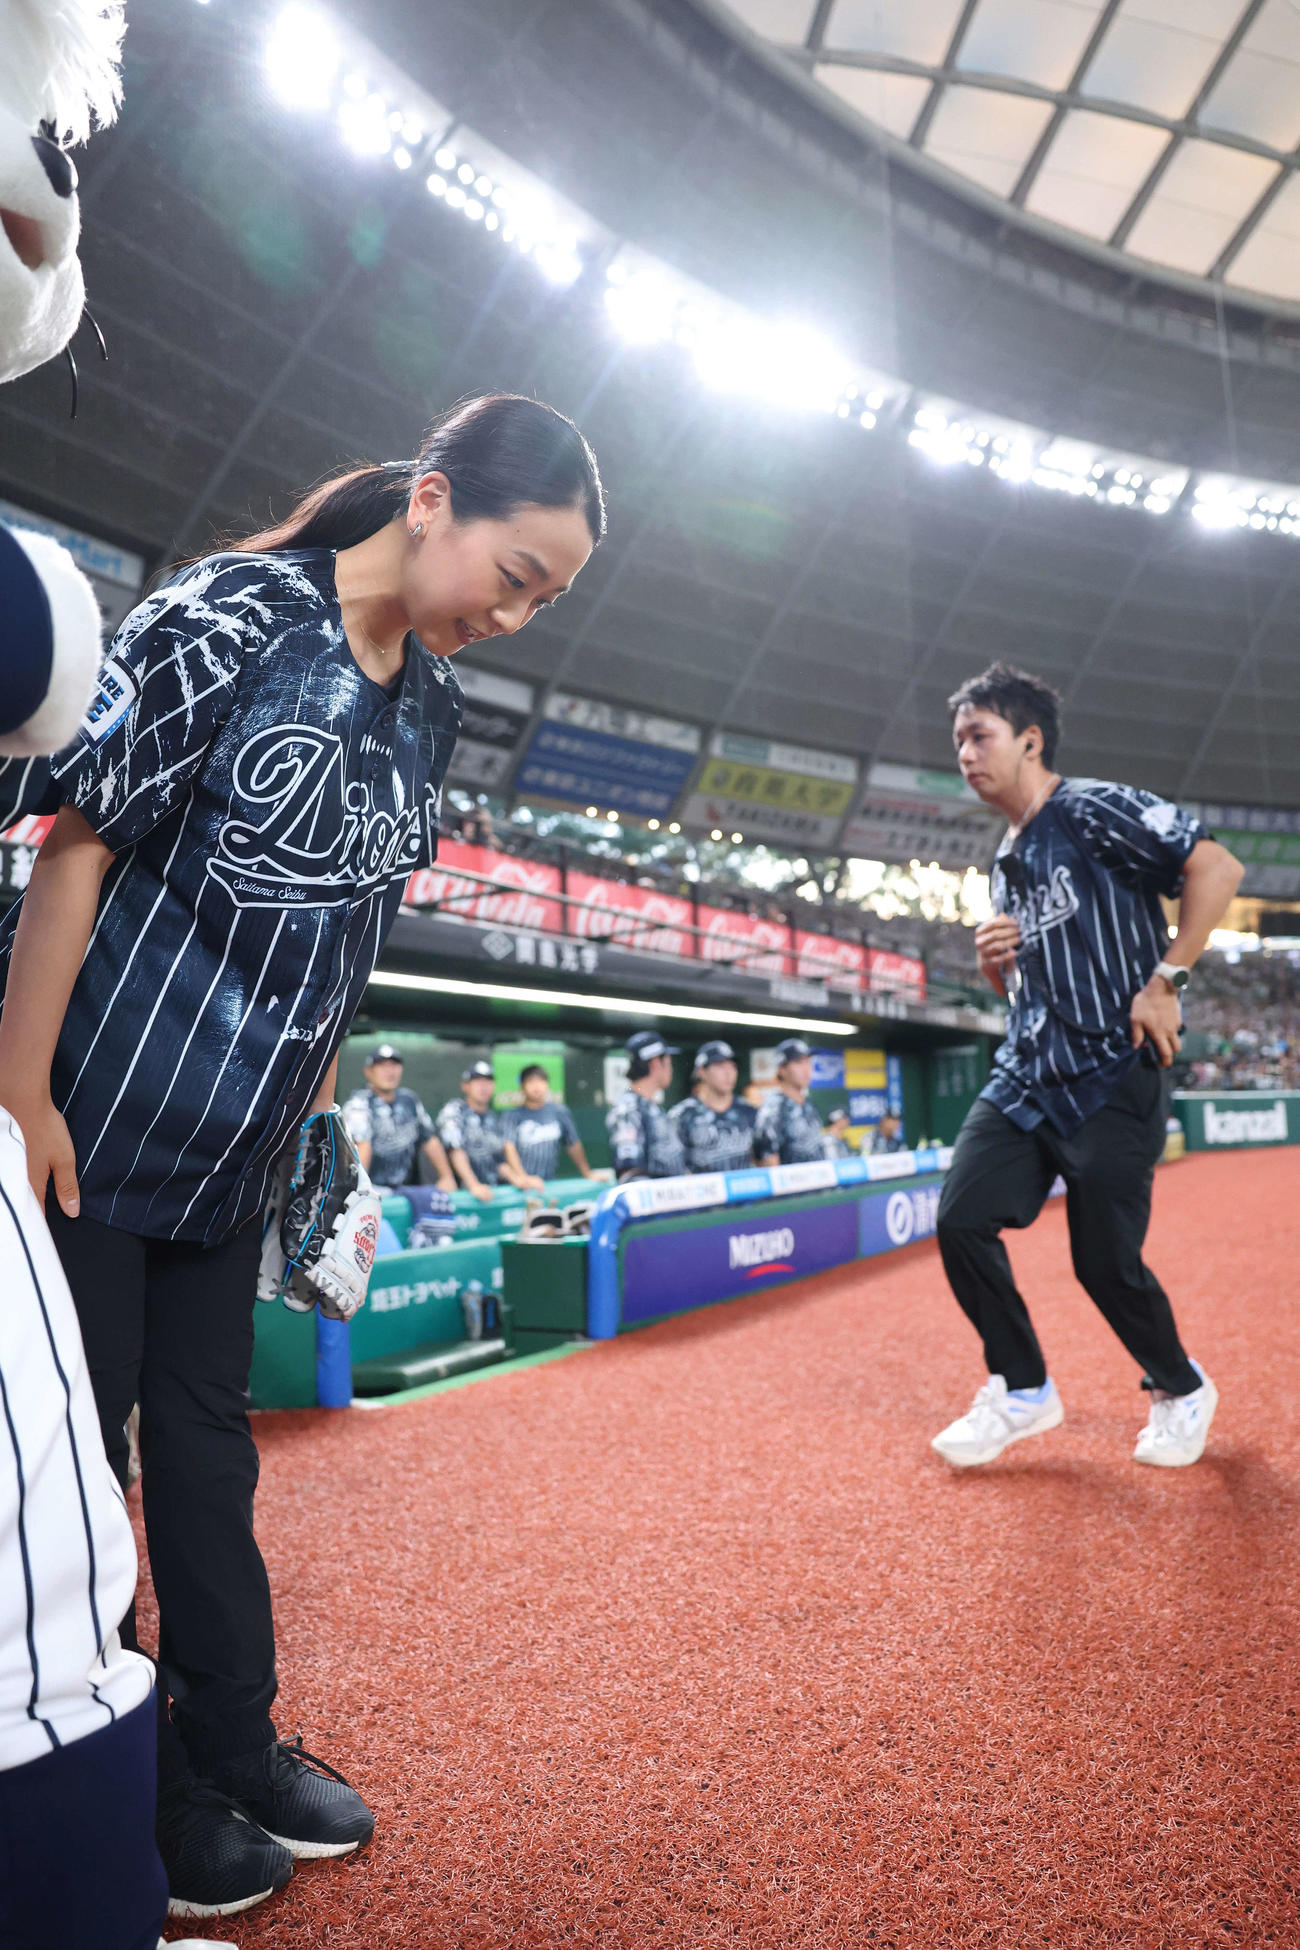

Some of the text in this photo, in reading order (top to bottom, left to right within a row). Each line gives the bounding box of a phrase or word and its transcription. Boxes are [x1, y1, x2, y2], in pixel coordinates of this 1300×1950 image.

[232, 877, 307, 901] Saitama Seibu
[729, 1227, 794, 1269] MIZUHO
